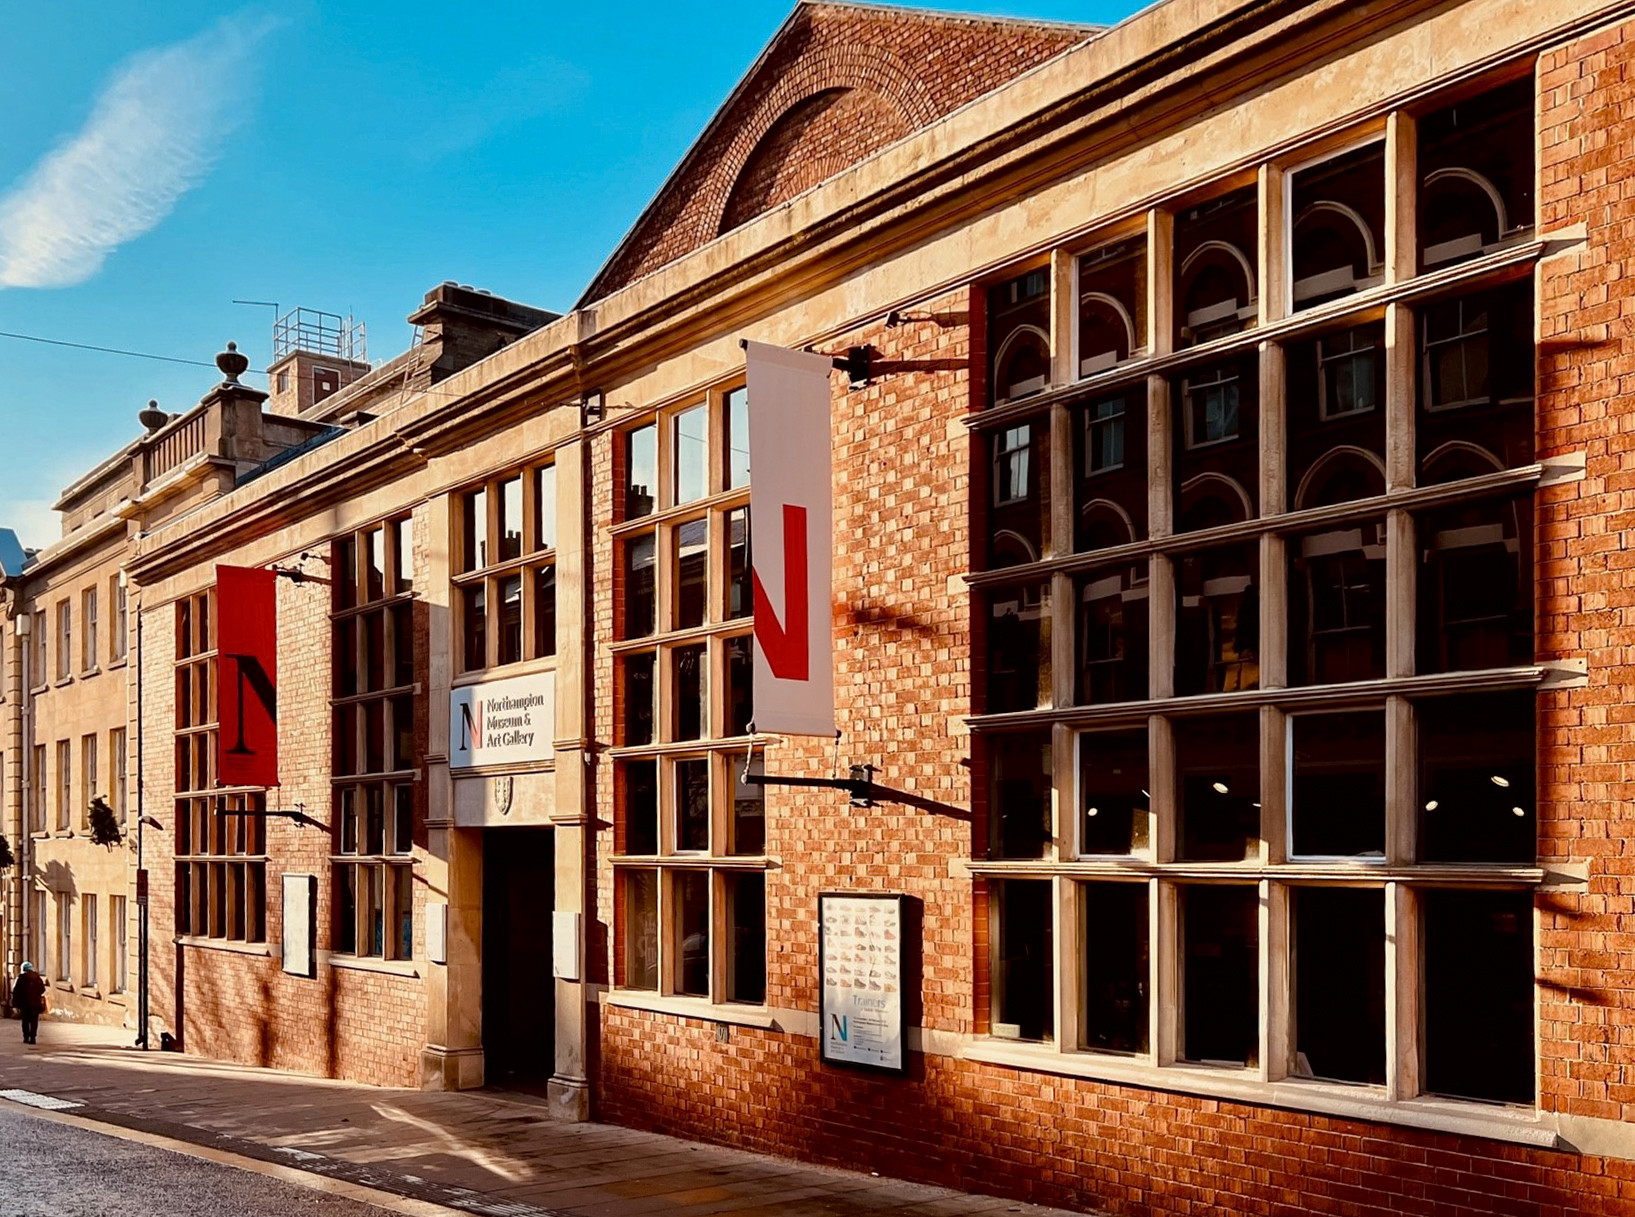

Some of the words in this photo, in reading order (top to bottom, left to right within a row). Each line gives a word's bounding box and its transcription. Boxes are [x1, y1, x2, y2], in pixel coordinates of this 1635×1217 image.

[487, 693, 544, 713] Northampton
[459, 700, 483, 751] N
[487, 715, 523, 730] Museum
[524, 713, 532, 725] &
[487, 733, 501, 748] Art
[503, 730, 534, 746] Gallery
[830, 1013, 848, 1041] N
